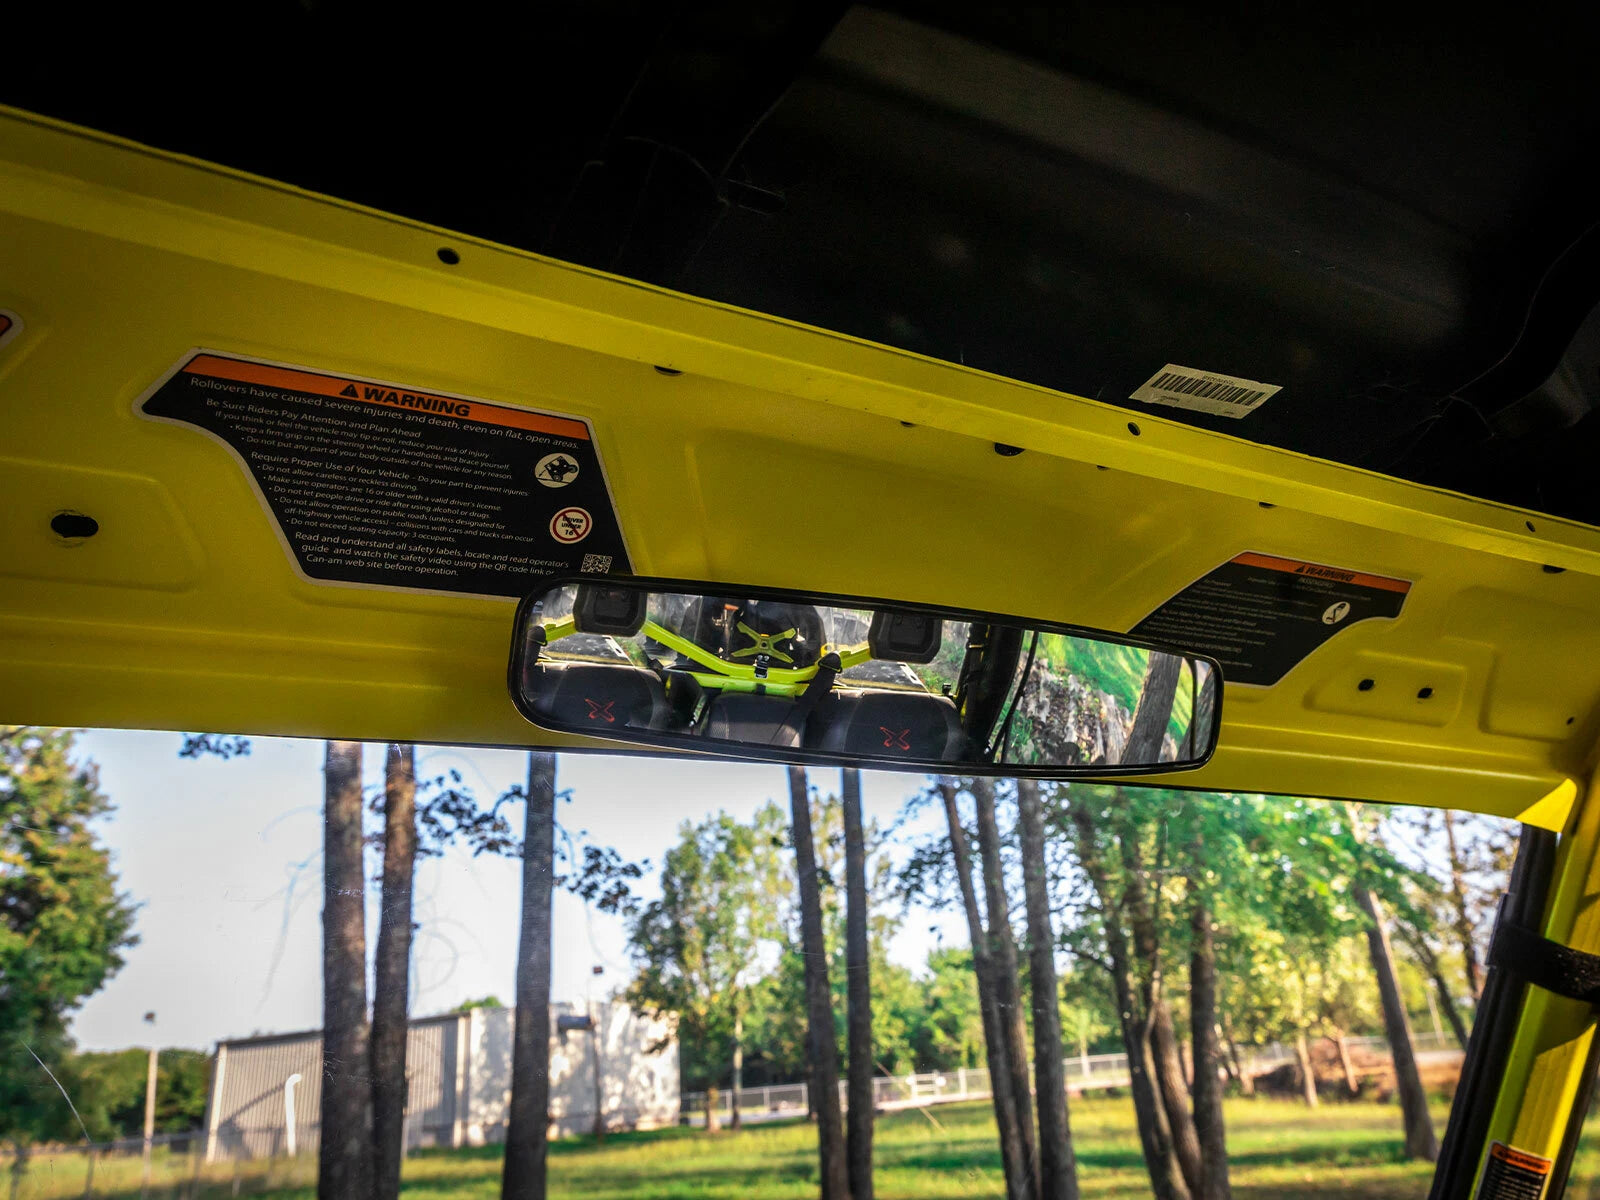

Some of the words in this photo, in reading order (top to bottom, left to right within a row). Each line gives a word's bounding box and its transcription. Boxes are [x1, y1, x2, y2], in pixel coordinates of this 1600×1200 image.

[190, 376, 246, 393] Rollovers
[249, 387, 278, 399] have
[281, 394, 322, 406] caused
[324, 401, 360, 412] severe
[363, 407, 402, 419] injuries
[405, 414, 425, 423] and
[428, 417, 460, 429] death,
[463, 424, 487, 433] even
[505, 429, 522, 440] flat,
[525, 435, 550, 443] open
[552, 439, 579, 448] areas.
[364, 387, 470, 417] WARNING
[206, 398, 219, 406] Be
[222, 400, 245, 410] Sure
[247, 404, 278, 416] Riders
[281, 409, 298, 420] Pay
[300, 413, 346, 426] Attention
[369, 423, 388, 432] Plan
[390, 427, 421, 437] Ahead
[242, 415, 264, 423] think
[277, 420, 292, 428] feel
[310, 426, 339, 435] vehicle
[340, 430, 357, 438] may
[398, 440, 424, 448] reduce
[235, 424, 256, 433] Keep
[266, 428, 283, 436] firm
[332, 439, 364, 449] steering
[401, 448, 441, 460] handholds
[458, 457, 479, 465] brace
[358, 451, 379, 461] body
[251, 451, 289, 463] Require
[291, 456, 322, 467] Proper
[324, 462, 343, 470] Use
[356, 466, 376, 474] Your
[378, 468, 410, 479] Vehicle
[267, 474, 290, 483] Make
[311, 481, 348, 490] operators
[315, 472, 346, 481] careless
[358, 478, 388, 486] reckless
[315, 492, 344, 500] people
[344, 495, 364, 503] drive
[410, 504, 431, 512] using
[432, 506, 459, 514] alcohol
[331, 504, 370, 512] operation
[455, 518, 494, 528] designated
[333, 514, 360, 522] vehicle
[396, 521, 429, 529] collisions
[348, 526, 376, 534] seating
[295, 531, 320, 541] Read
[341, 538, 394, 549] understand
[407, 544, 435, 554] safety
[464, 550, 490, 559] locate
[301, 544, 329, 552] guide
[383, 551, 398, 559] the
[400, 553, 427, 564] safety
[428, 557, 452, 565] video
[454, 560, 477, 569] using
[494, 563, 507, 571] QR
[306, 553, 342, 564] Can-am
[383, 561, 413, 571] before
[414, 566, 459, 575] operation.
[1306, 568, 1355, 582] WARNING
